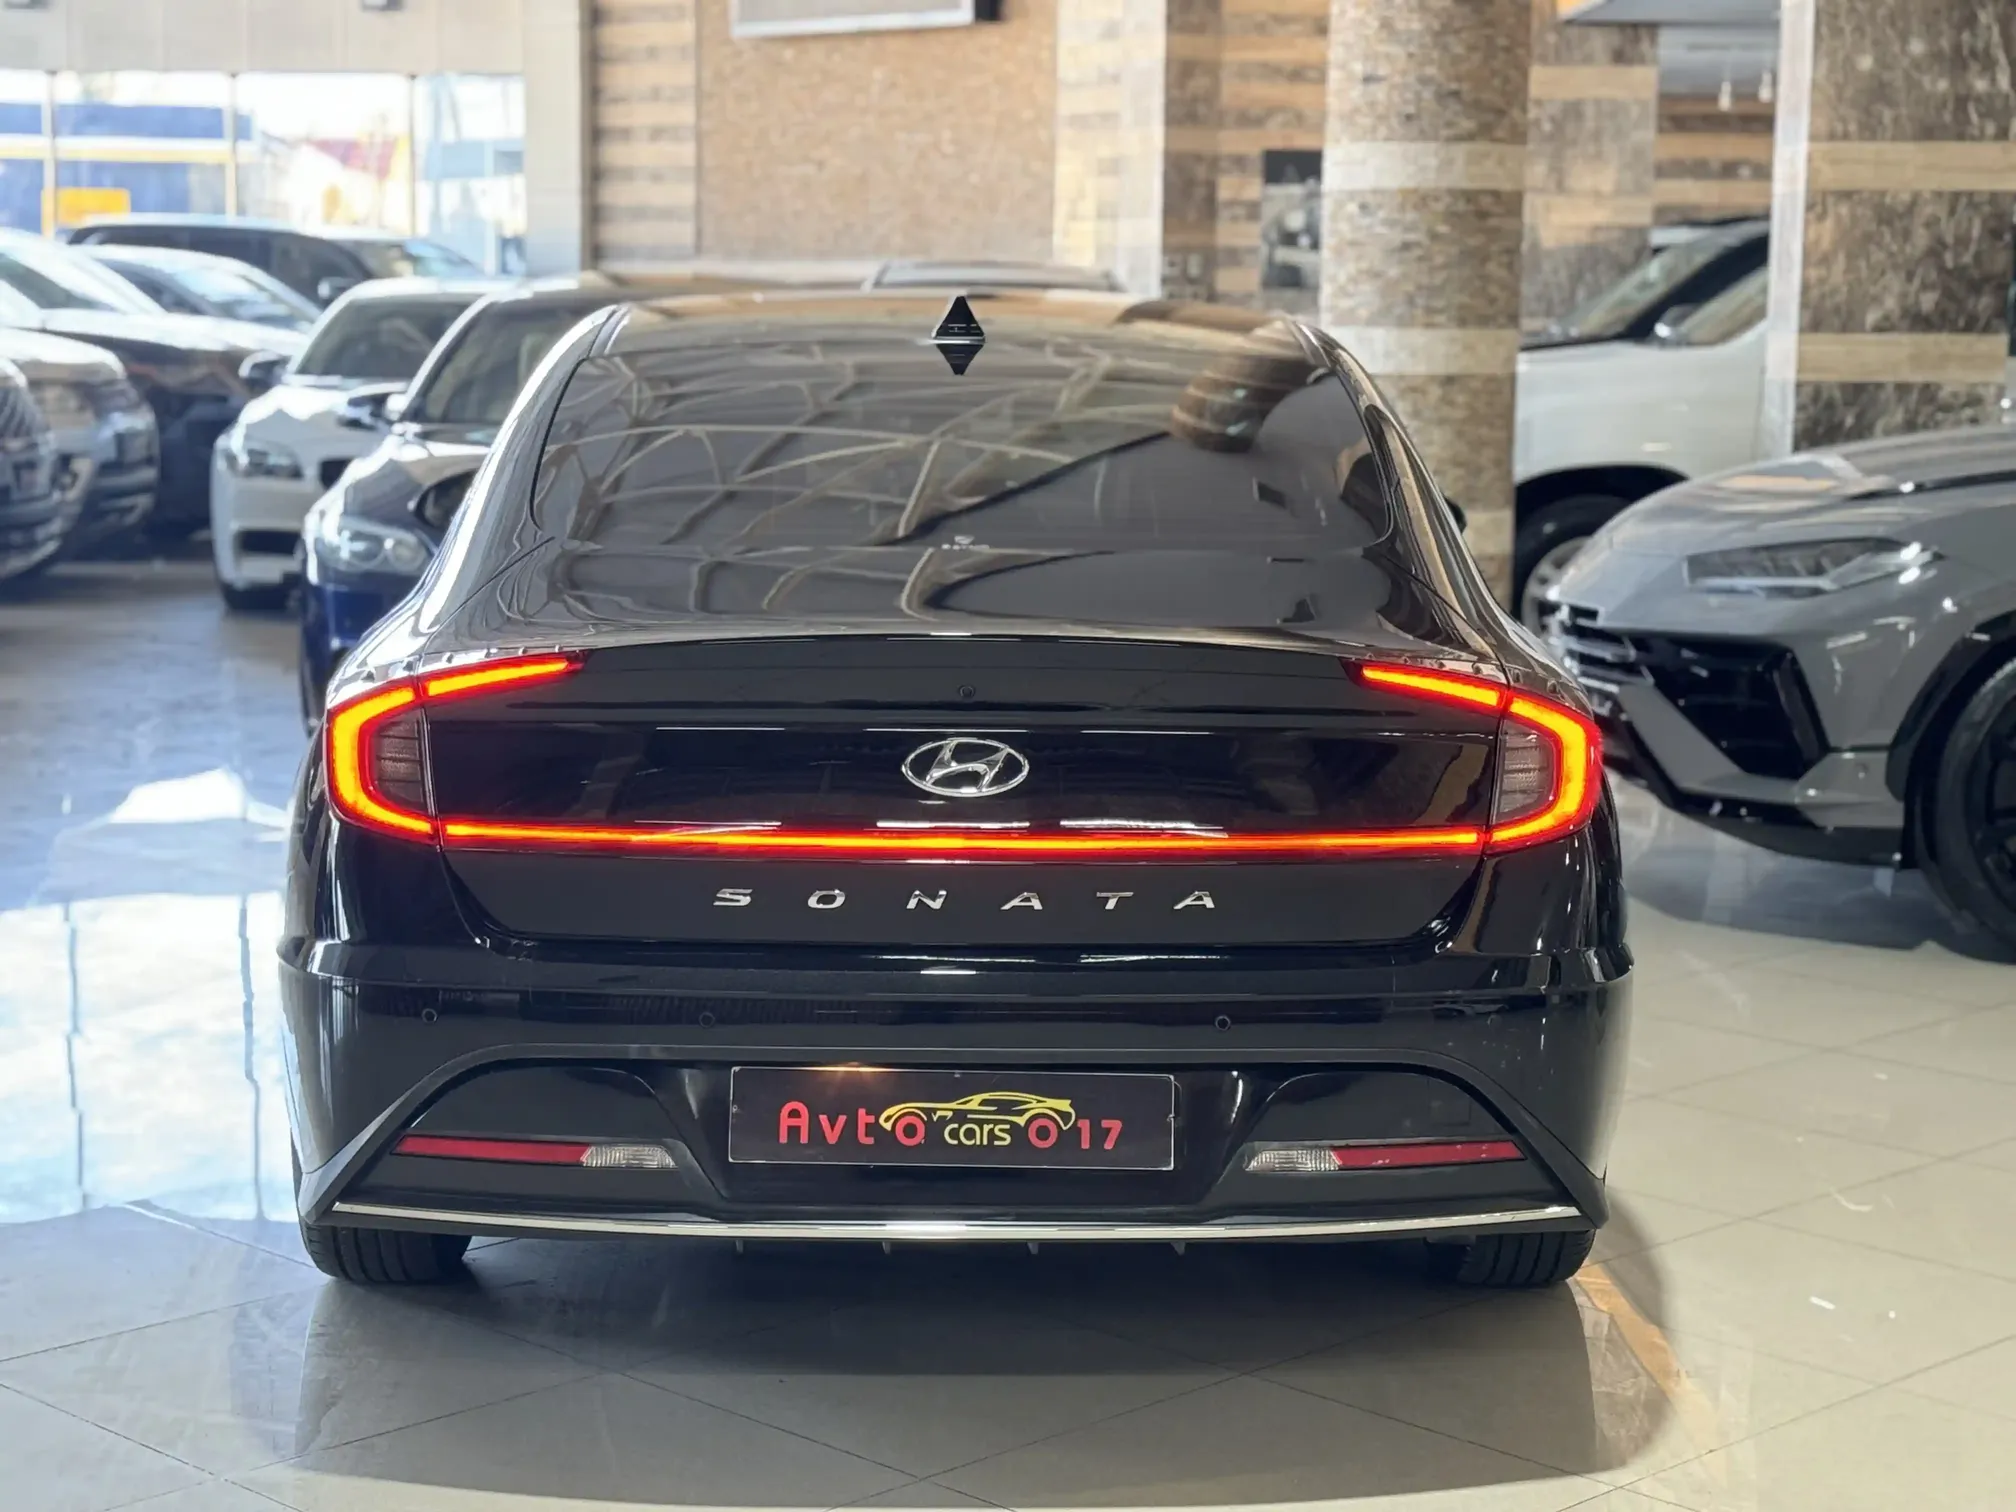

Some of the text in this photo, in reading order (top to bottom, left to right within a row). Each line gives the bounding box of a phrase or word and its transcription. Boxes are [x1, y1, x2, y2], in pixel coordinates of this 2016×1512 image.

[713, 888, 1216, 911] SONATA
[779, 1101, 925, 1146] Avto
[944, 1122, 1012, 1146] cars
